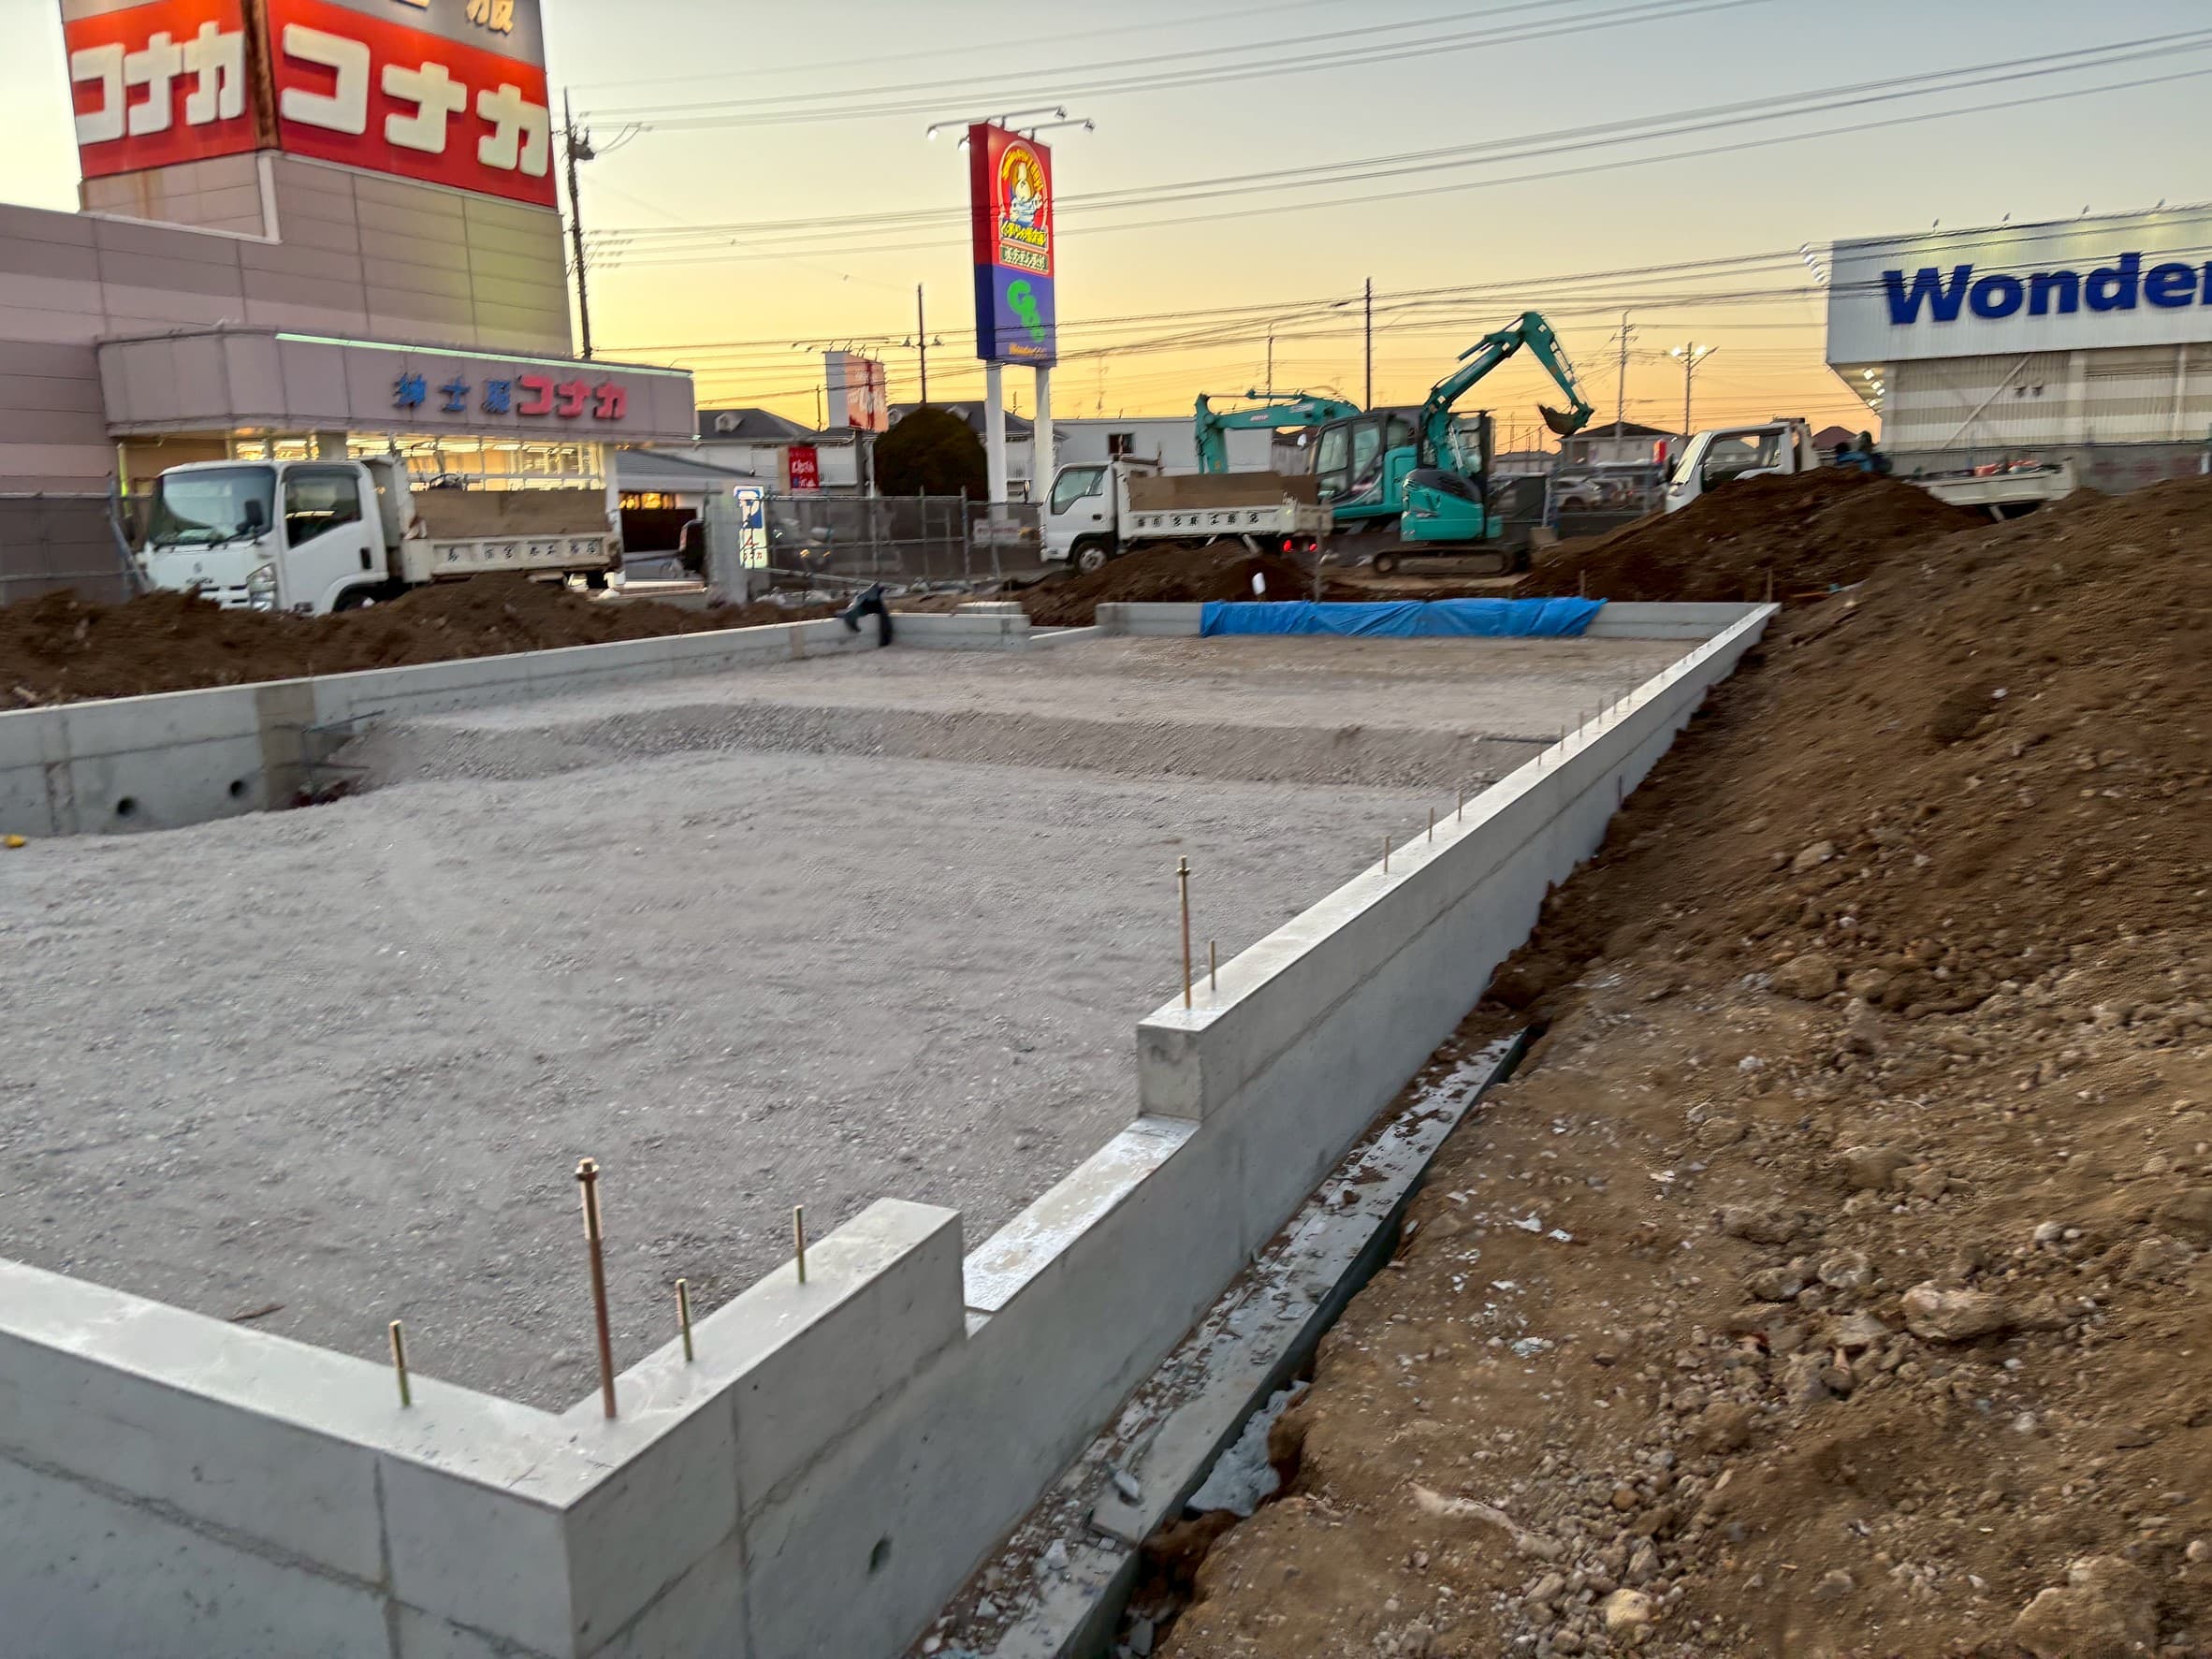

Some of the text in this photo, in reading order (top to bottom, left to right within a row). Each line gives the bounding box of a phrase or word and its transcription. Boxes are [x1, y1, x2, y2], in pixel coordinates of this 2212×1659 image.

[71, 22, 245, 144] コナカ
[281, 22, 549, 178] コナカ
[1882, 251, 2212, 326] Wonde
